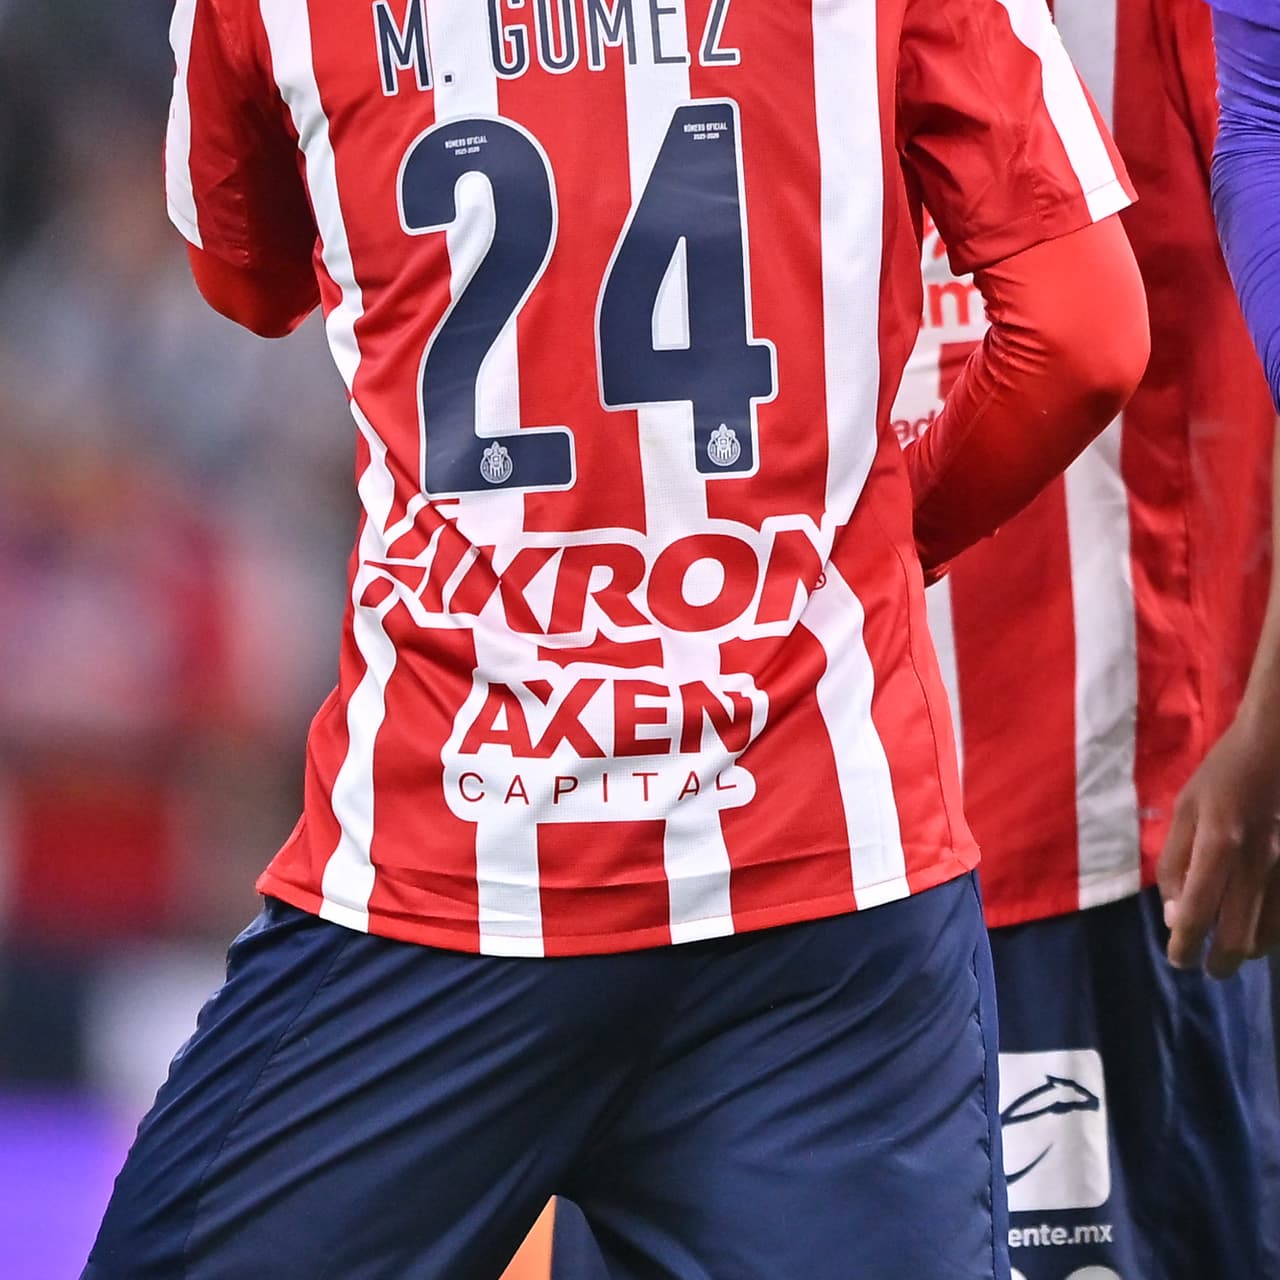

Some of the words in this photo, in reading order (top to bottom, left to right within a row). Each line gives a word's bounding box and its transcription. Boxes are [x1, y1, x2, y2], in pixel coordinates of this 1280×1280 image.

[399, 98, 779, 499] 24
[457, 678, 754, 759] AXEN
[458, 770, 738, 806] CAPITAL
